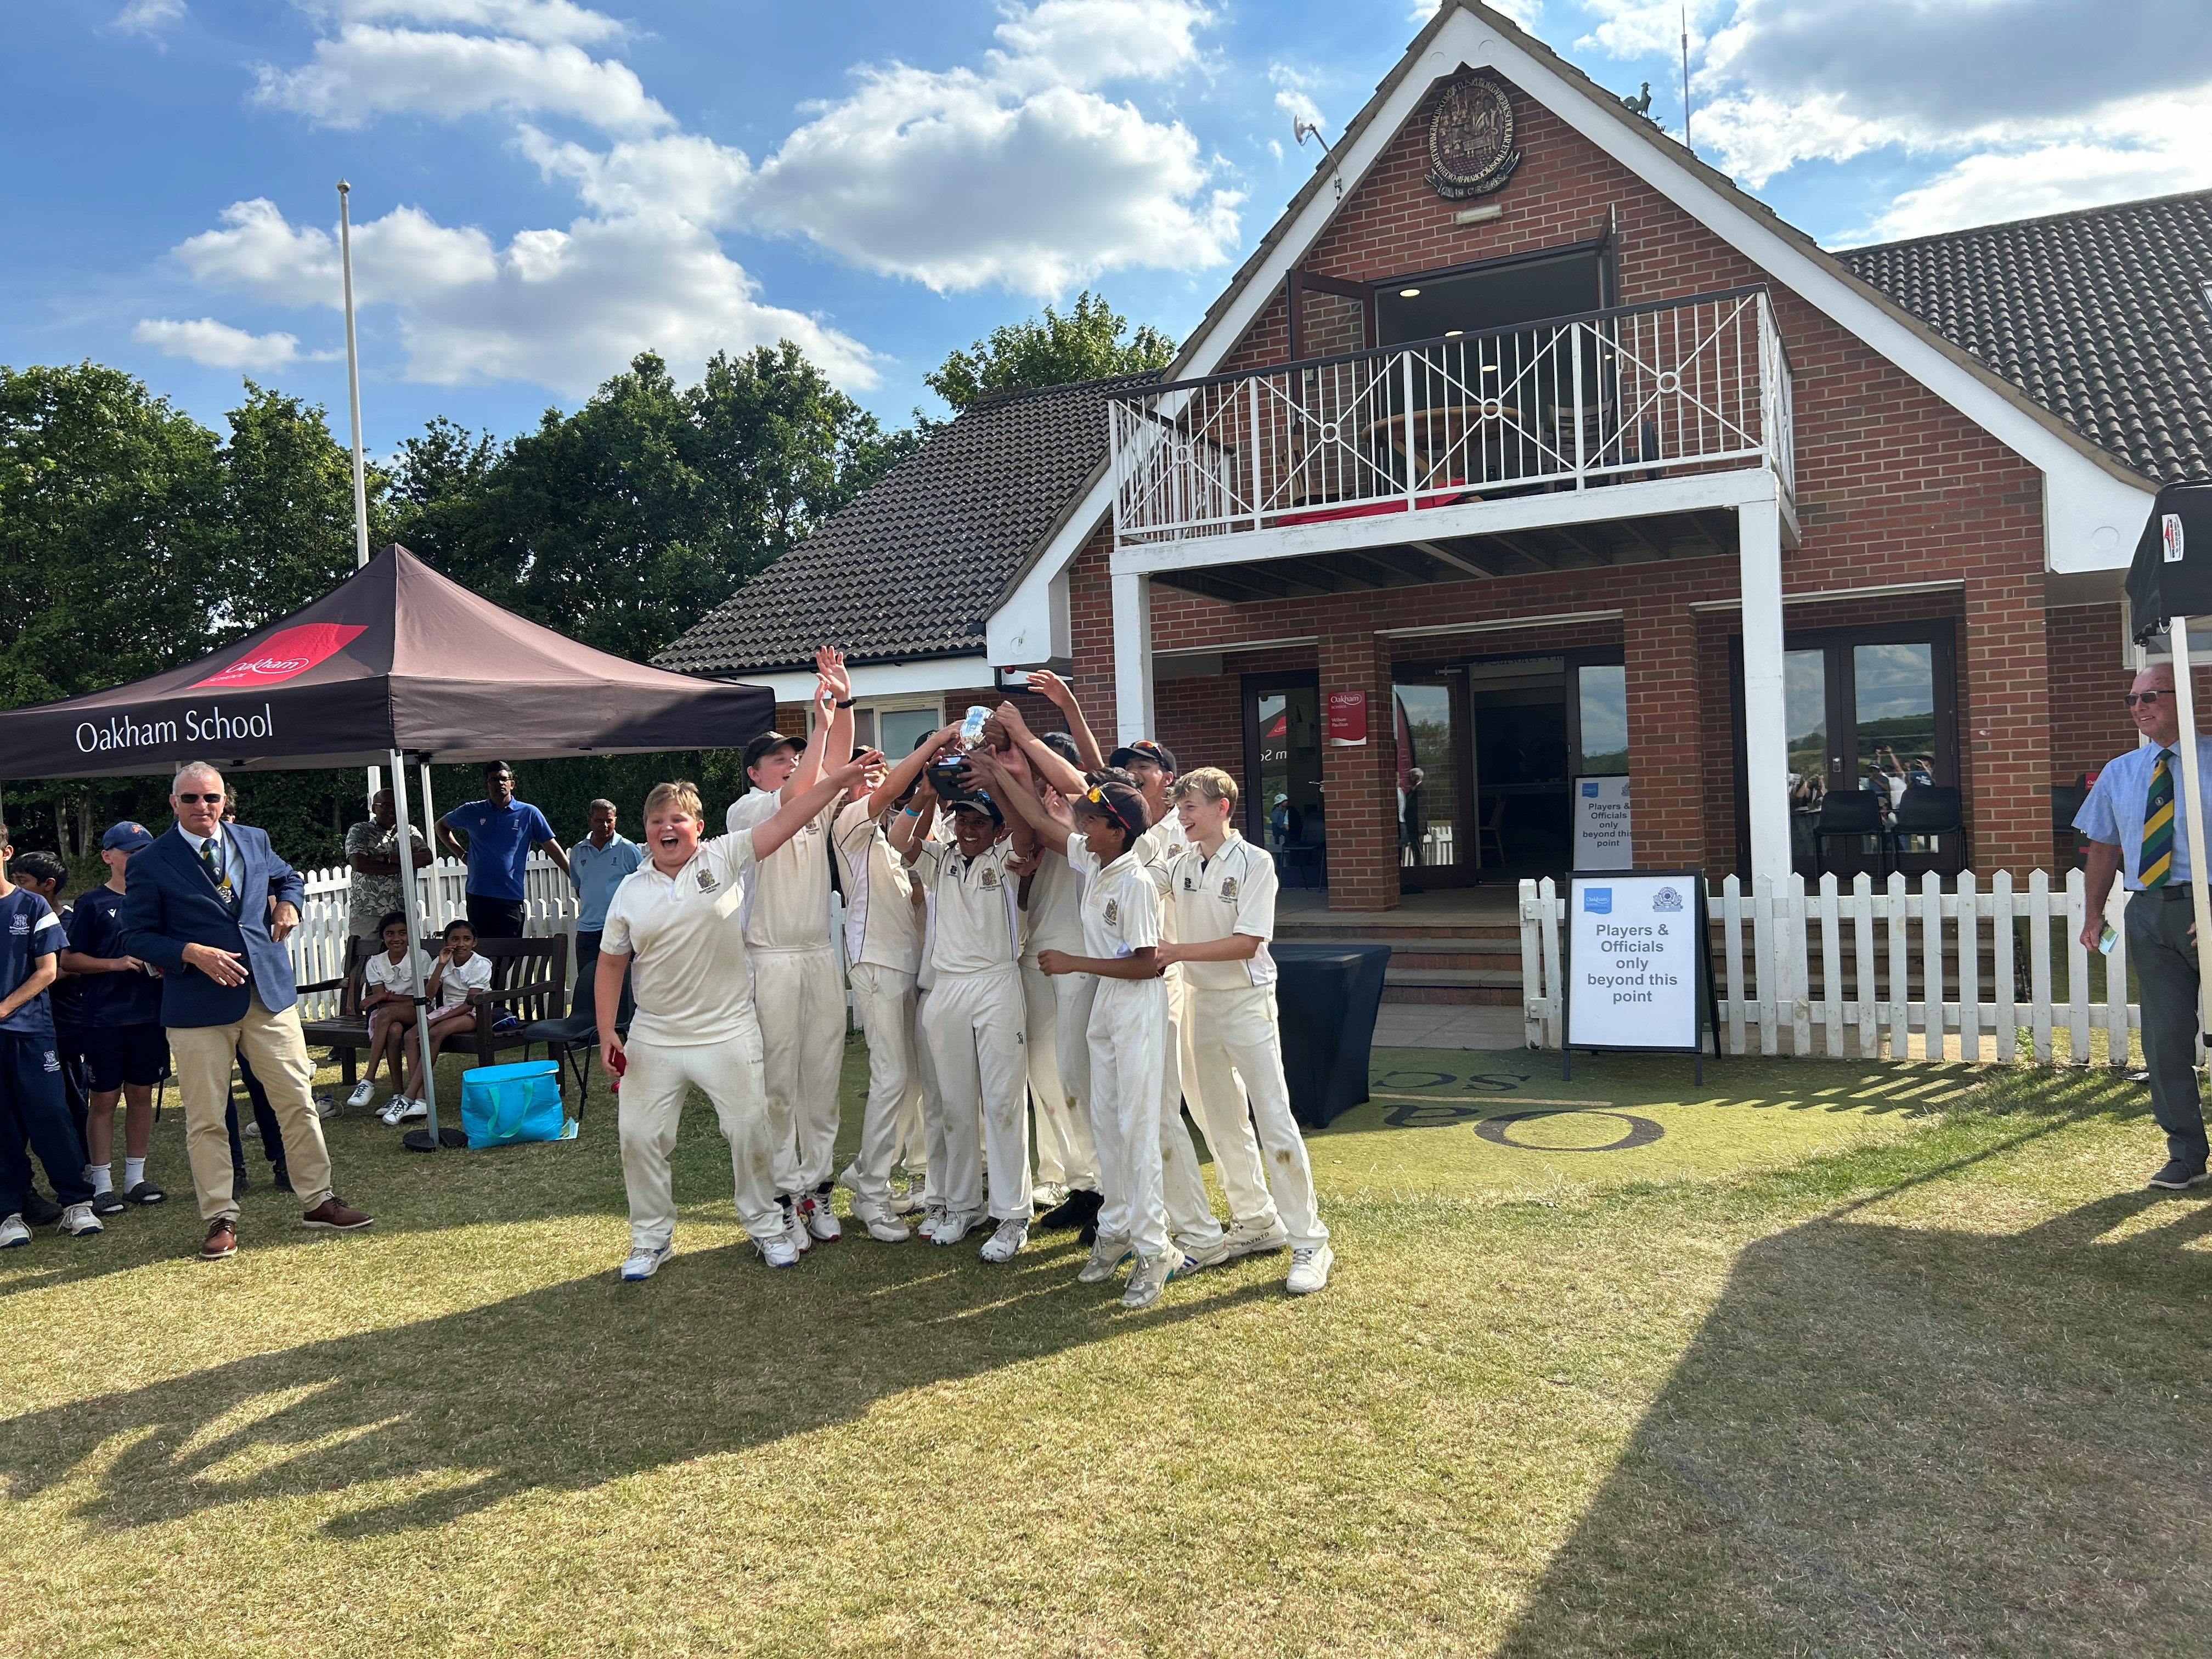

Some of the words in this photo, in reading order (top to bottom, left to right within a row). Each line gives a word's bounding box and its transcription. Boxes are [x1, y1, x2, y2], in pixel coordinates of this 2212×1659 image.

[225, 658, 309, 674] Oakham
[1330, 693, 1362, 705] Oakham
[76, 715, 177, 752] Oakham
[186, 703, 273, 741] School
[1588, 803, 1621, 811] Players
[1583, 830, 1615, 839] beyond
[1585, 896, 1610, 904] Oakham
[1596, 924, 1652, 939] Players
[1658, 924, 1669, 935] &
[1601, 940, 1664, 953] Officials
[1616, 957, 1649, 972] only
[1587, 974, 1644, 989] beyond
[1649, 974, 1678, 985] this
[1612, 990, 1652, 1005] point
